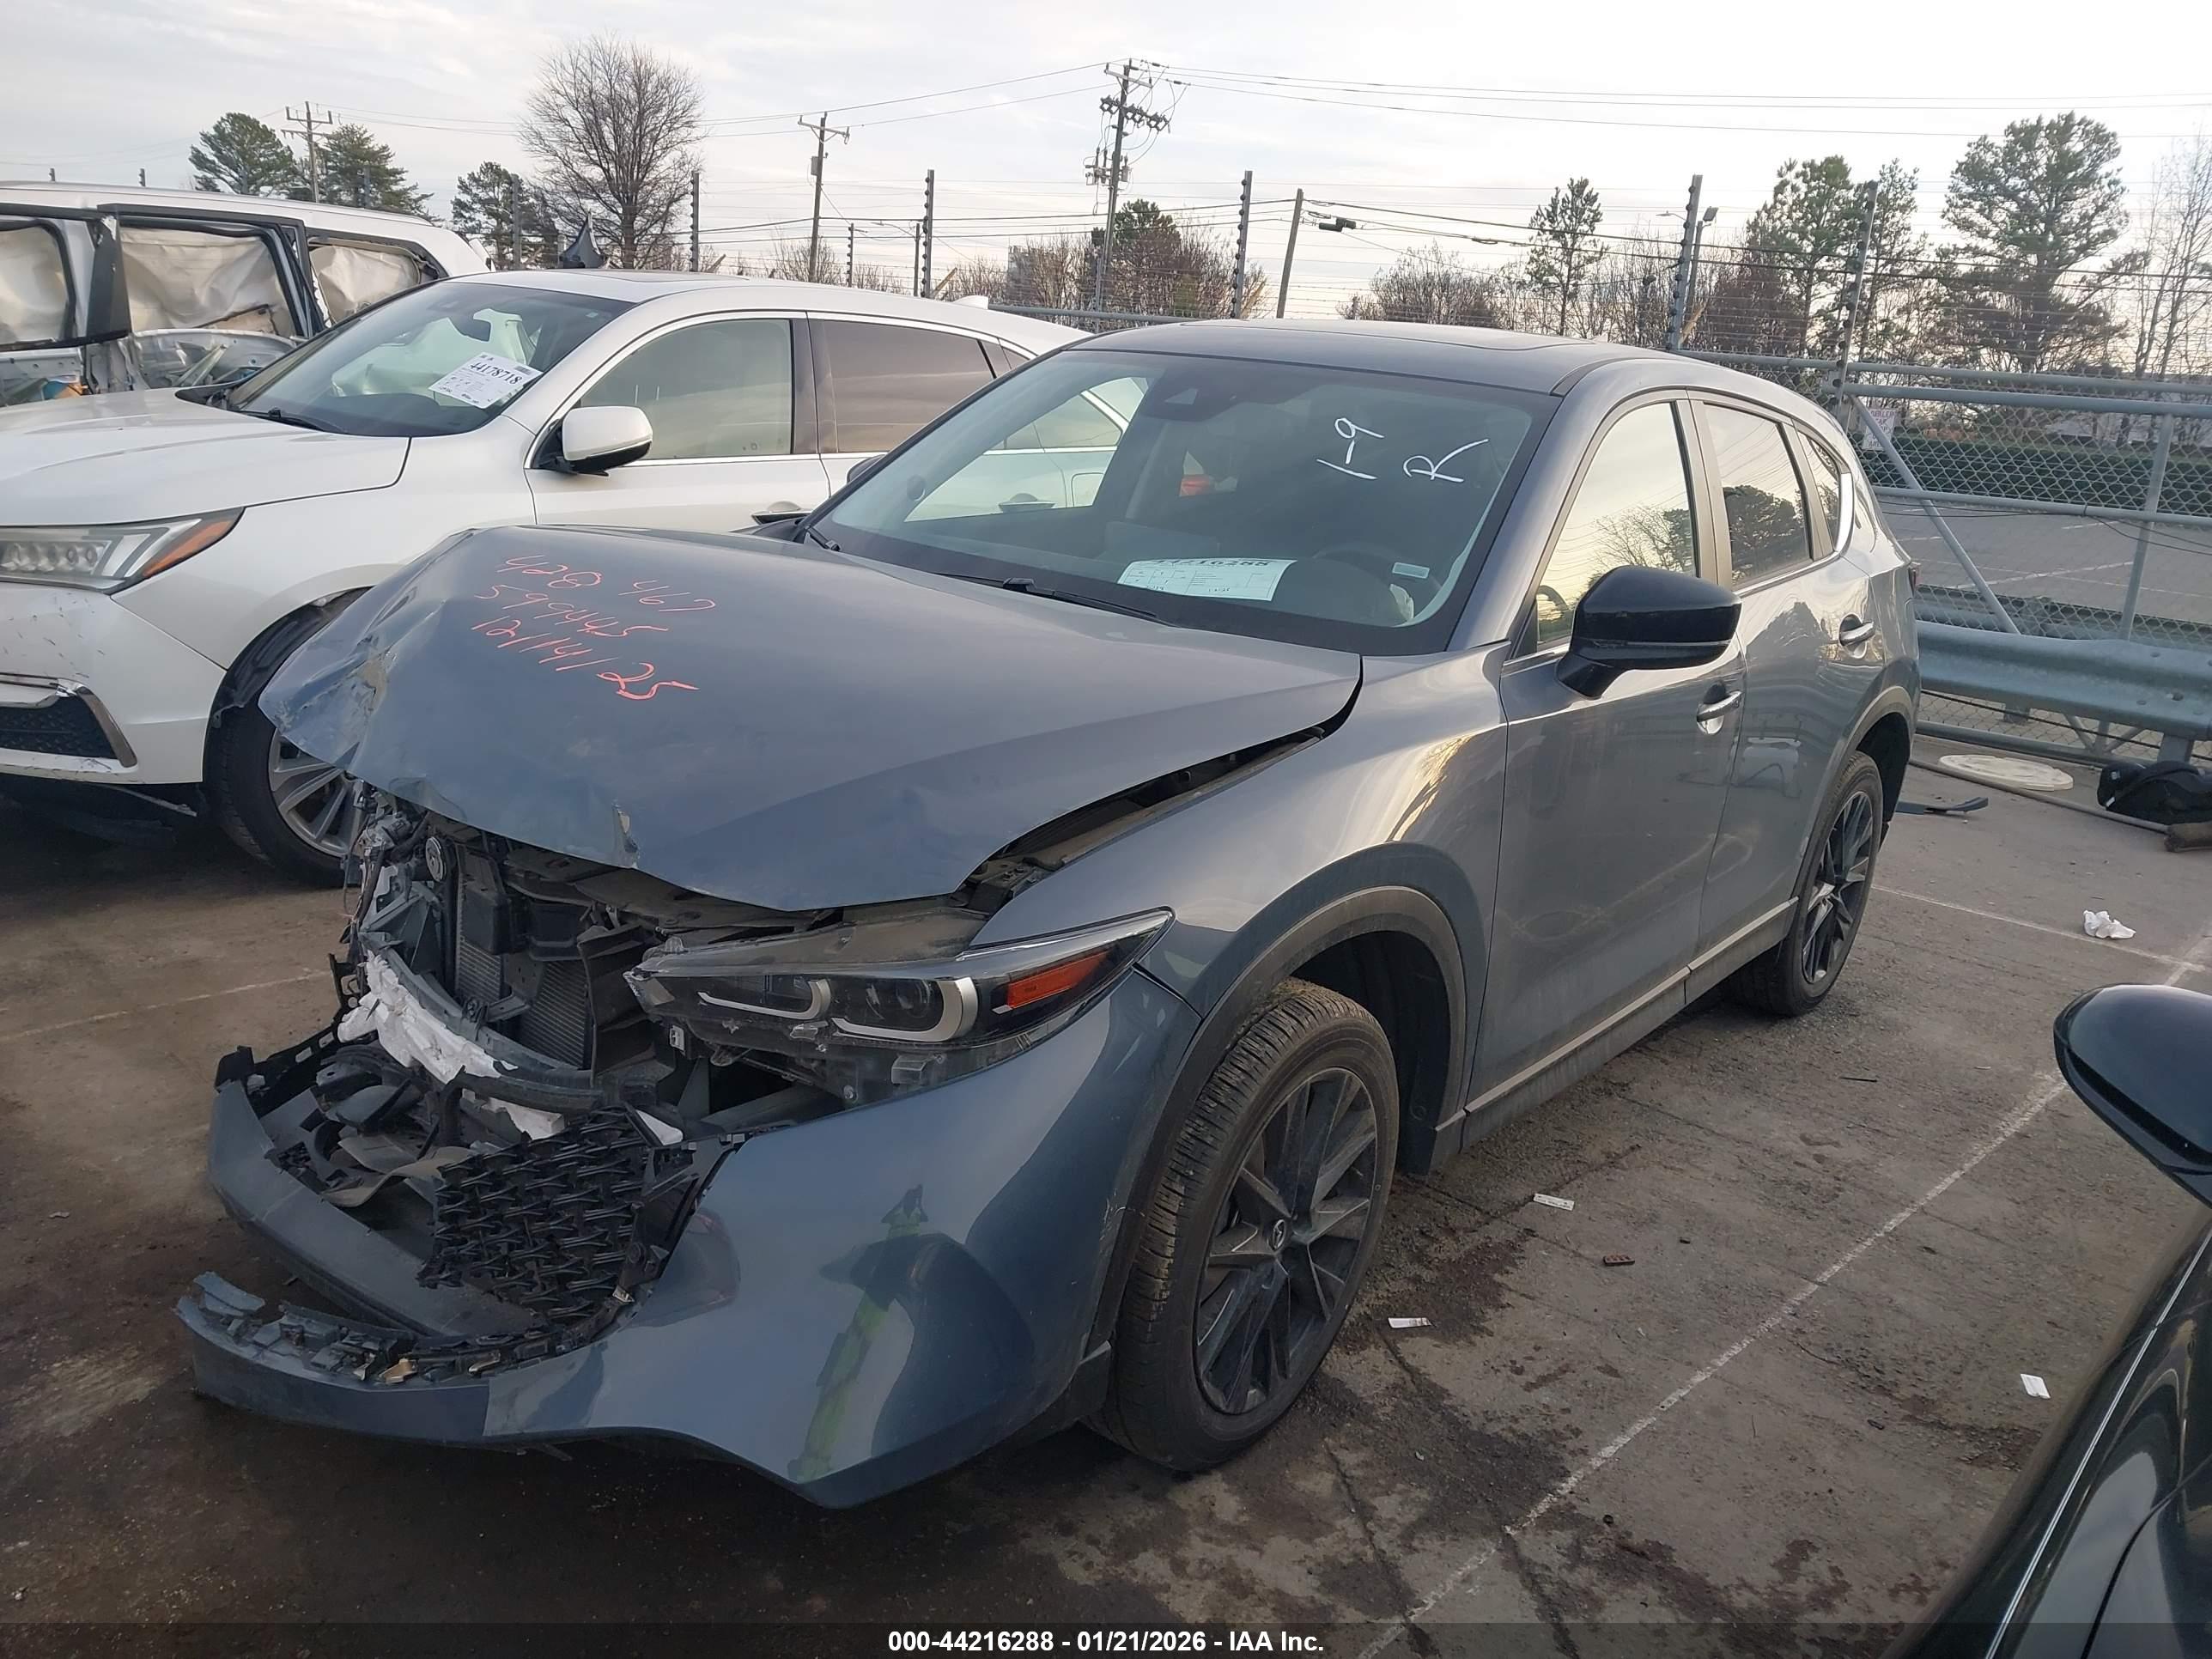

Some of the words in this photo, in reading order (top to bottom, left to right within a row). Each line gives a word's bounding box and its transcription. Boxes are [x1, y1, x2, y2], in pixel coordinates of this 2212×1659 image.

[470, 362, 523, 385] 44178718
[1403, 438, 1490, 483] R
[473, 584, 670, 638] 599445
[617, 580, 716, 612] 467
[471, 616, 700, 701] 12/14/25
